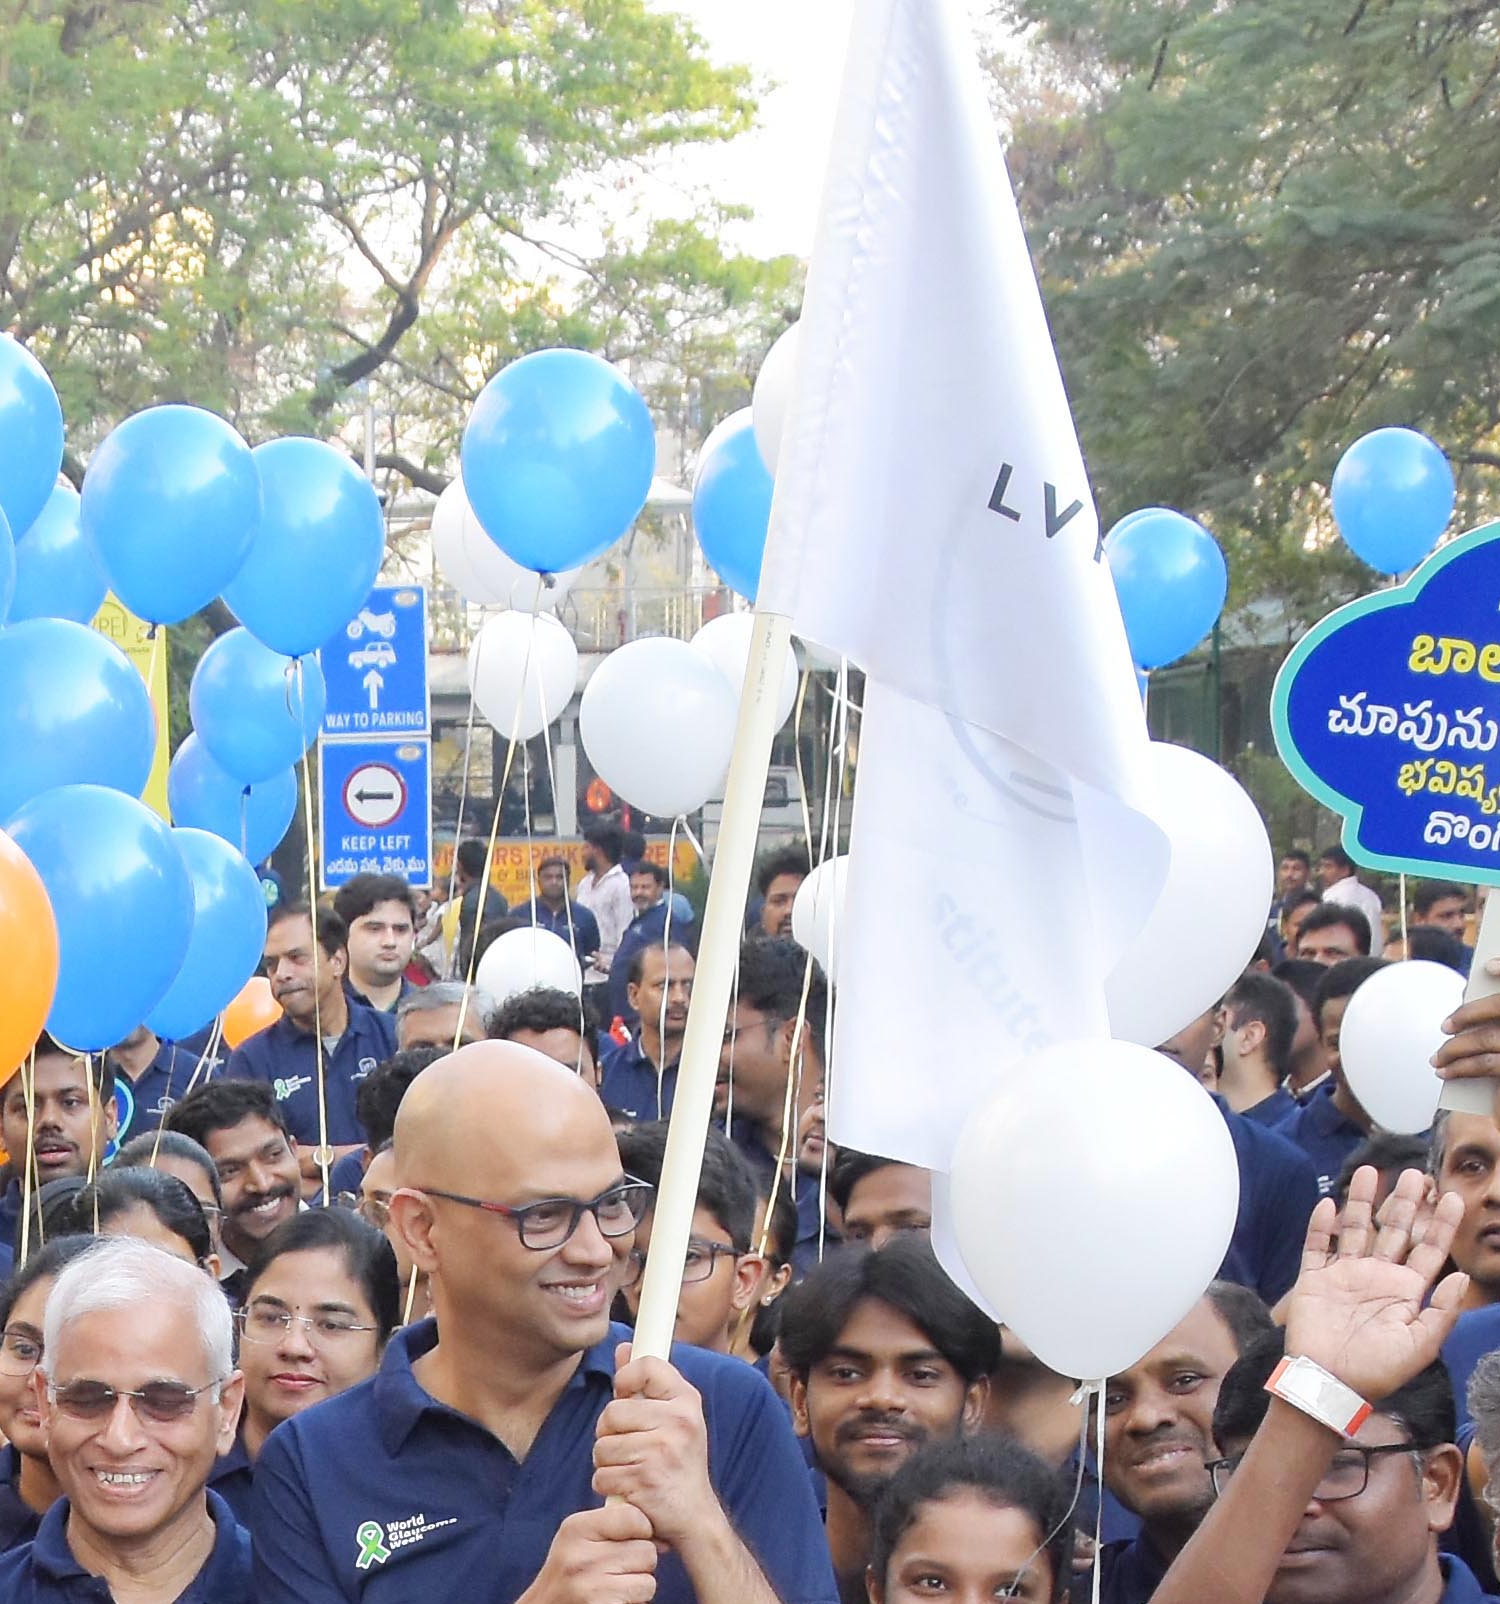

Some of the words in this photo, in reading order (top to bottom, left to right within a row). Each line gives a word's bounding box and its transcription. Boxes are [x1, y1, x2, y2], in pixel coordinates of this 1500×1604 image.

[987, 462, 1021, 521] L
[1044, 481, 1083, 538] V
[326, 714, 350, 728] WAY
[353, 713, 368, 727] TO
[372, 710, 424, 726] PARKING
[1327, 691, 1499, 752] చూపును
[342, 836, 376, 850] KEEP
[380, 835, 411, 850] LEFT
[387, 1513, 425, 1532] World
[388, 1517, 457, 1541] Glaucoma
[390, 1533, 424, 1550] Week
